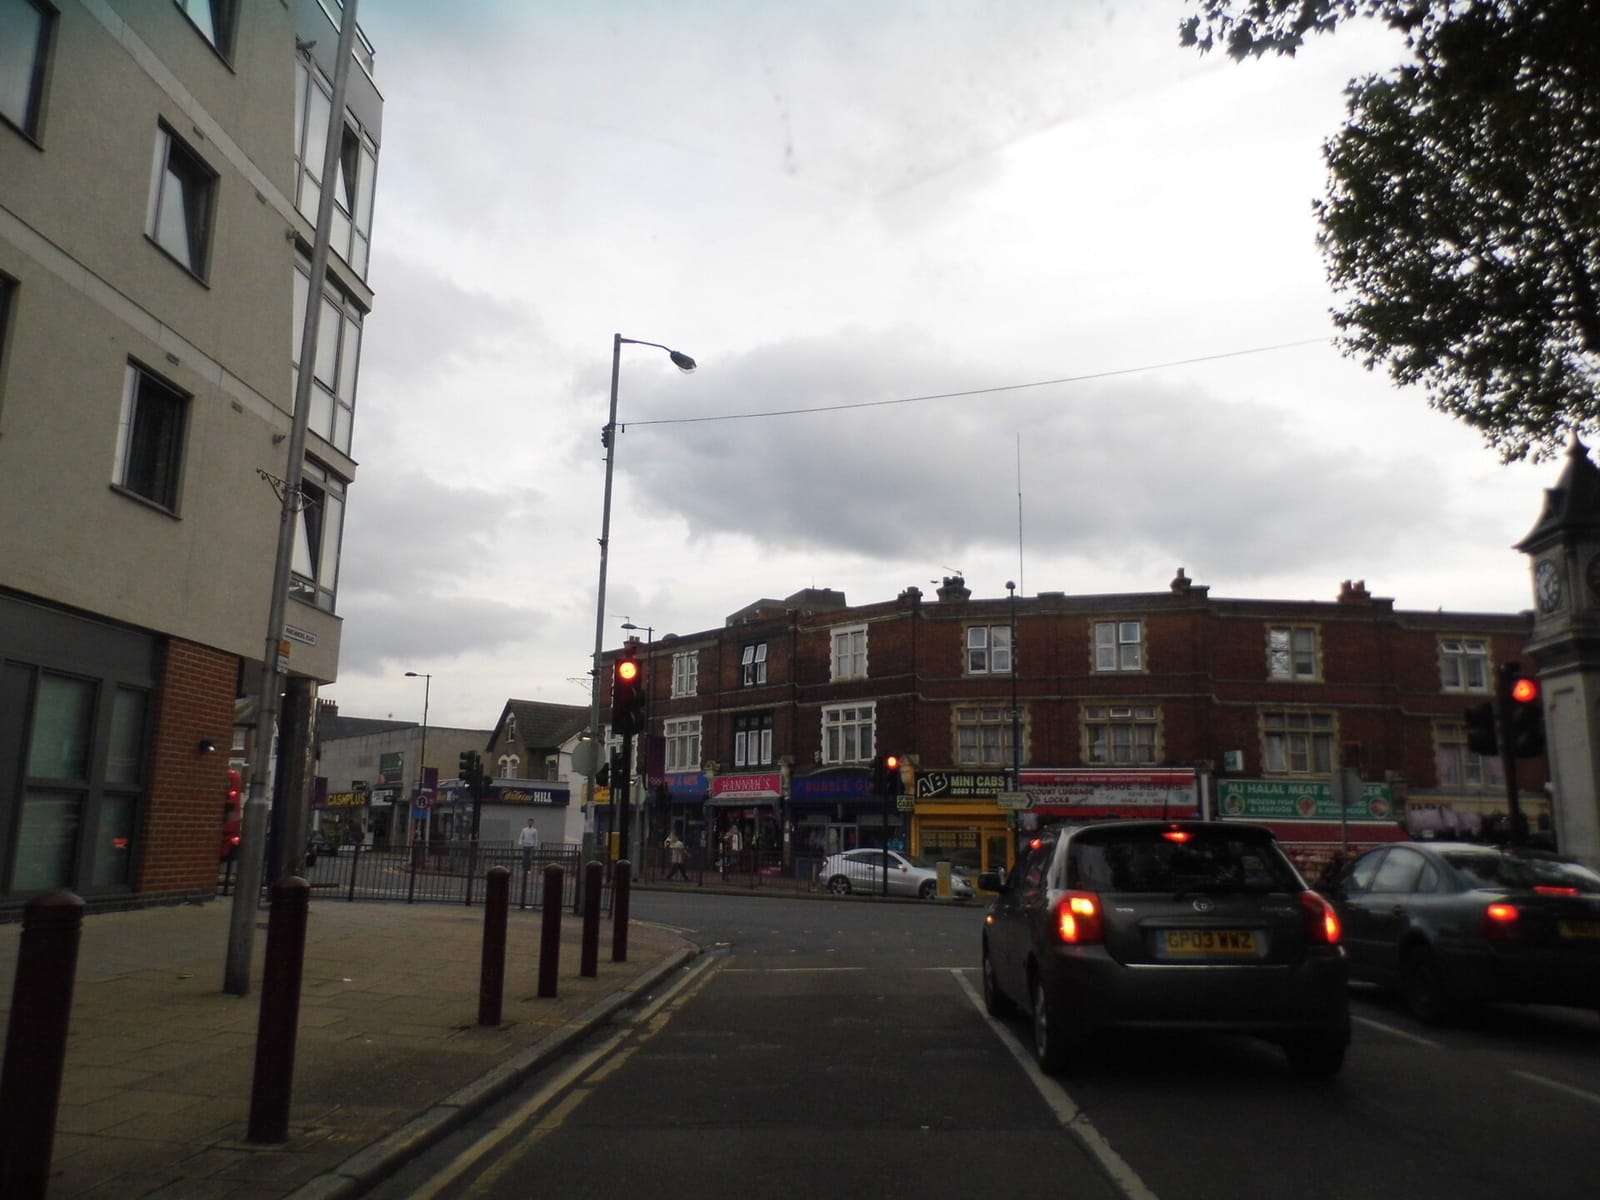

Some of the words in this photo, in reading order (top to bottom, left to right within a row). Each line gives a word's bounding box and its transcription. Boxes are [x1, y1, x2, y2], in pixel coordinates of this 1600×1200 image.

[721, 777, 771, 791] HANNAH'S
[951, 776, 974, 787] MINI
[976, 776, 1005, 787] CABS
[1058, 787, 1095, 796] LUGGAGE
[1247, 783, 1286, 794] HALAL
[1287, 784, 1319, 796] MEAT
[534, 791, 553, 803] HILL
[1167, 931, 1214, 948] GP03
